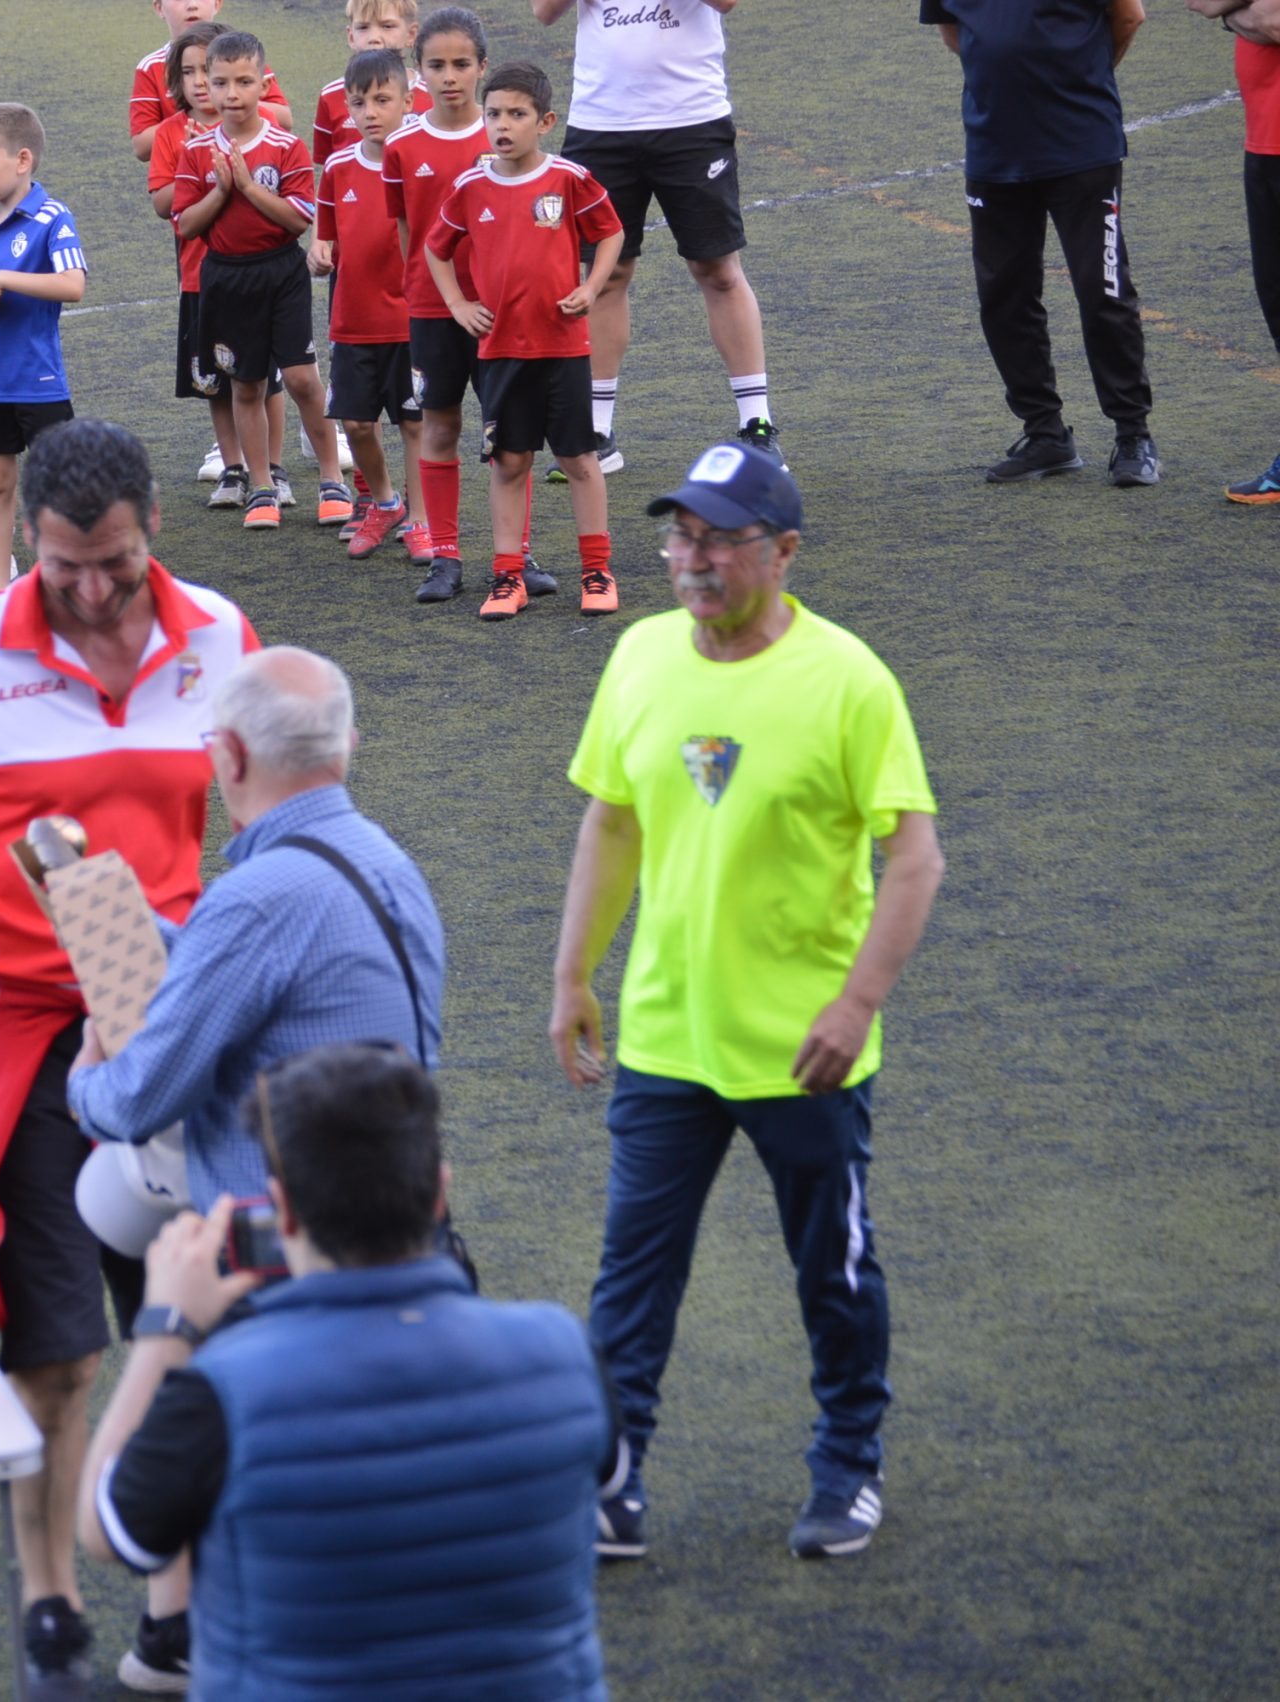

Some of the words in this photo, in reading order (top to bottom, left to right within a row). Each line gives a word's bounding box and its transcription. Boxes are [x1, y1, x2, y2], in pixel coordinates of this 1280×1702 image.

[602, 4, 673, 28] Budda
[659, 20, 680, 29] CLUB
[1103, 213, 1119, 298] LEGEA
